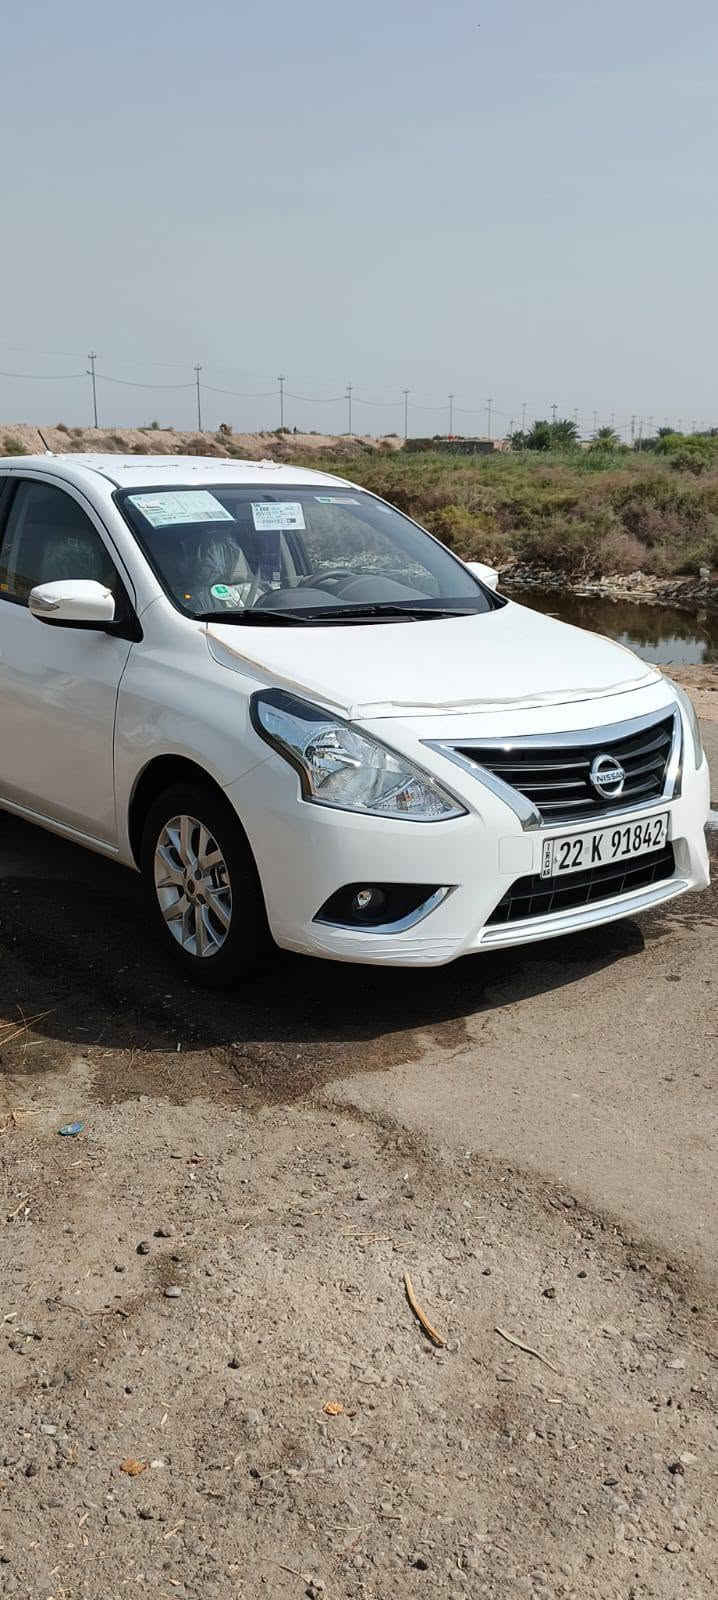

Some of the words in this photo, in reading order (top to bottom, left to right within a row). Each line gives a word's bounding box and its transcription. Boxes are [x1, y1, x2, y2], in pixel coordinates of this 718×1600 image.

[596, 771, 623, 783] NISSAN
[559, 839, 584, 870] 22
[591, 834, 603, 862] K
[612, 819, 663, 858] 91842
